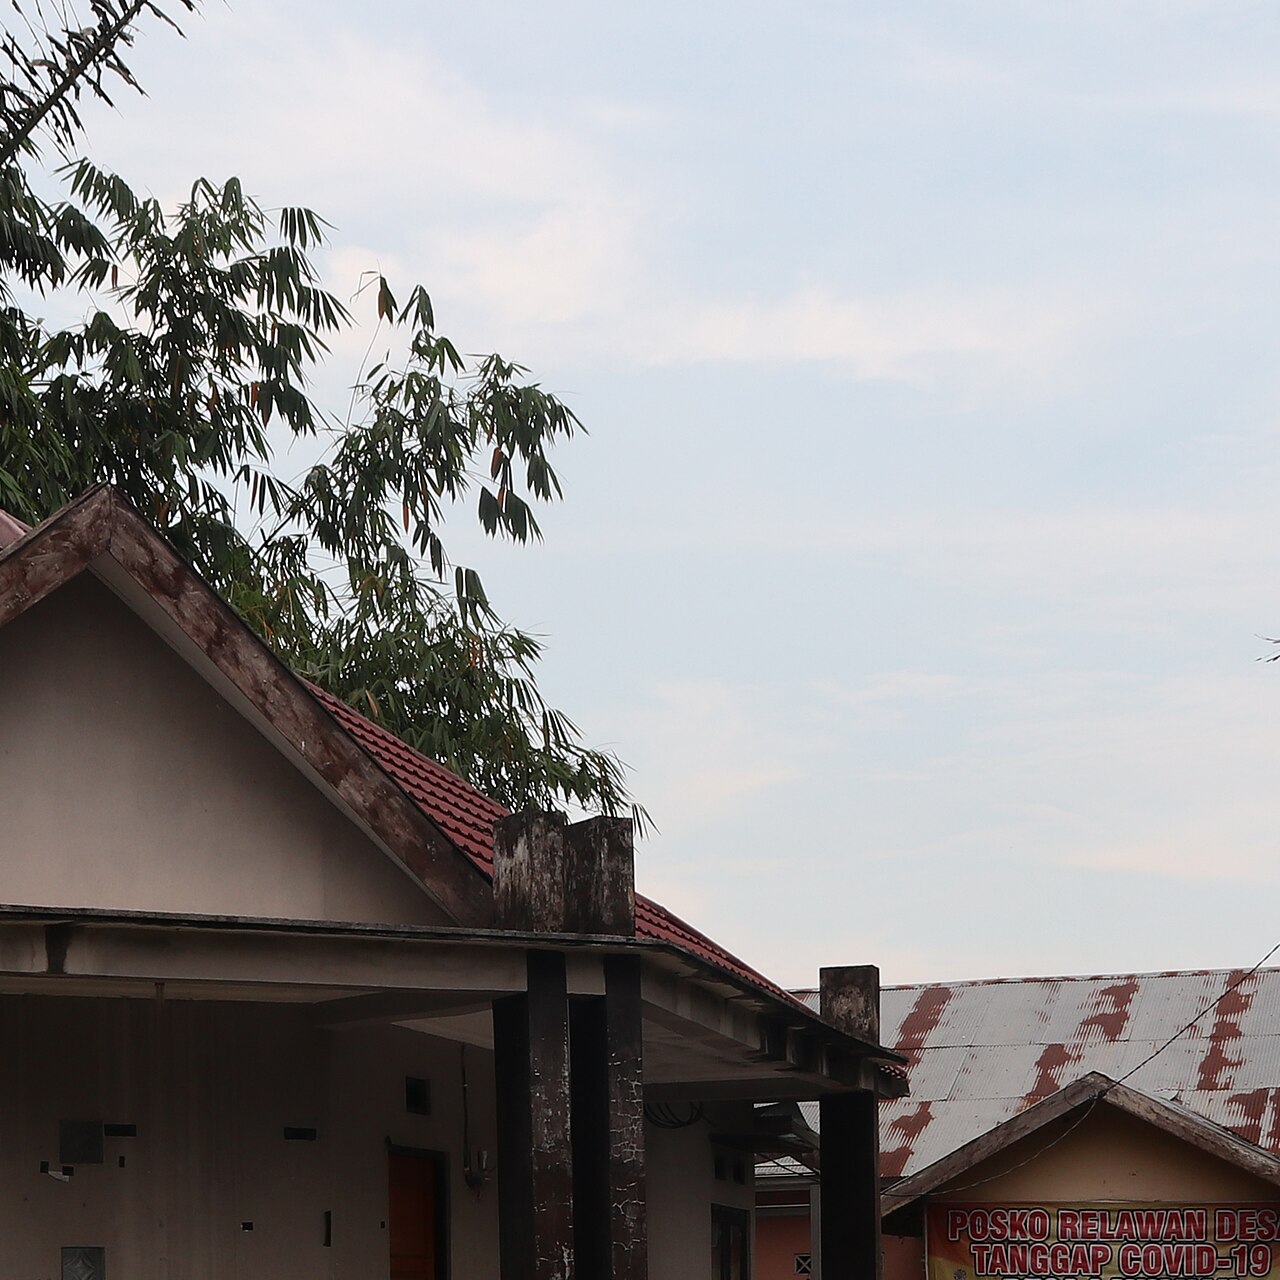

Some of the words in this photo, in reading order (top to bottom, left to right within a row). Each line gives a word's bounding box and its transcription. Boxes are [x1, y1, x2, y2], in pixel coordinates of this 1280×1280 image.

[948, 1209, 1049, 1241] POSKO
[1058, 1209, 1206, 1241] RELAWAN
[970, 1243, 1111, 1276] TANGGAP
[1119, 1243, 1271, 1277] COVID-19
